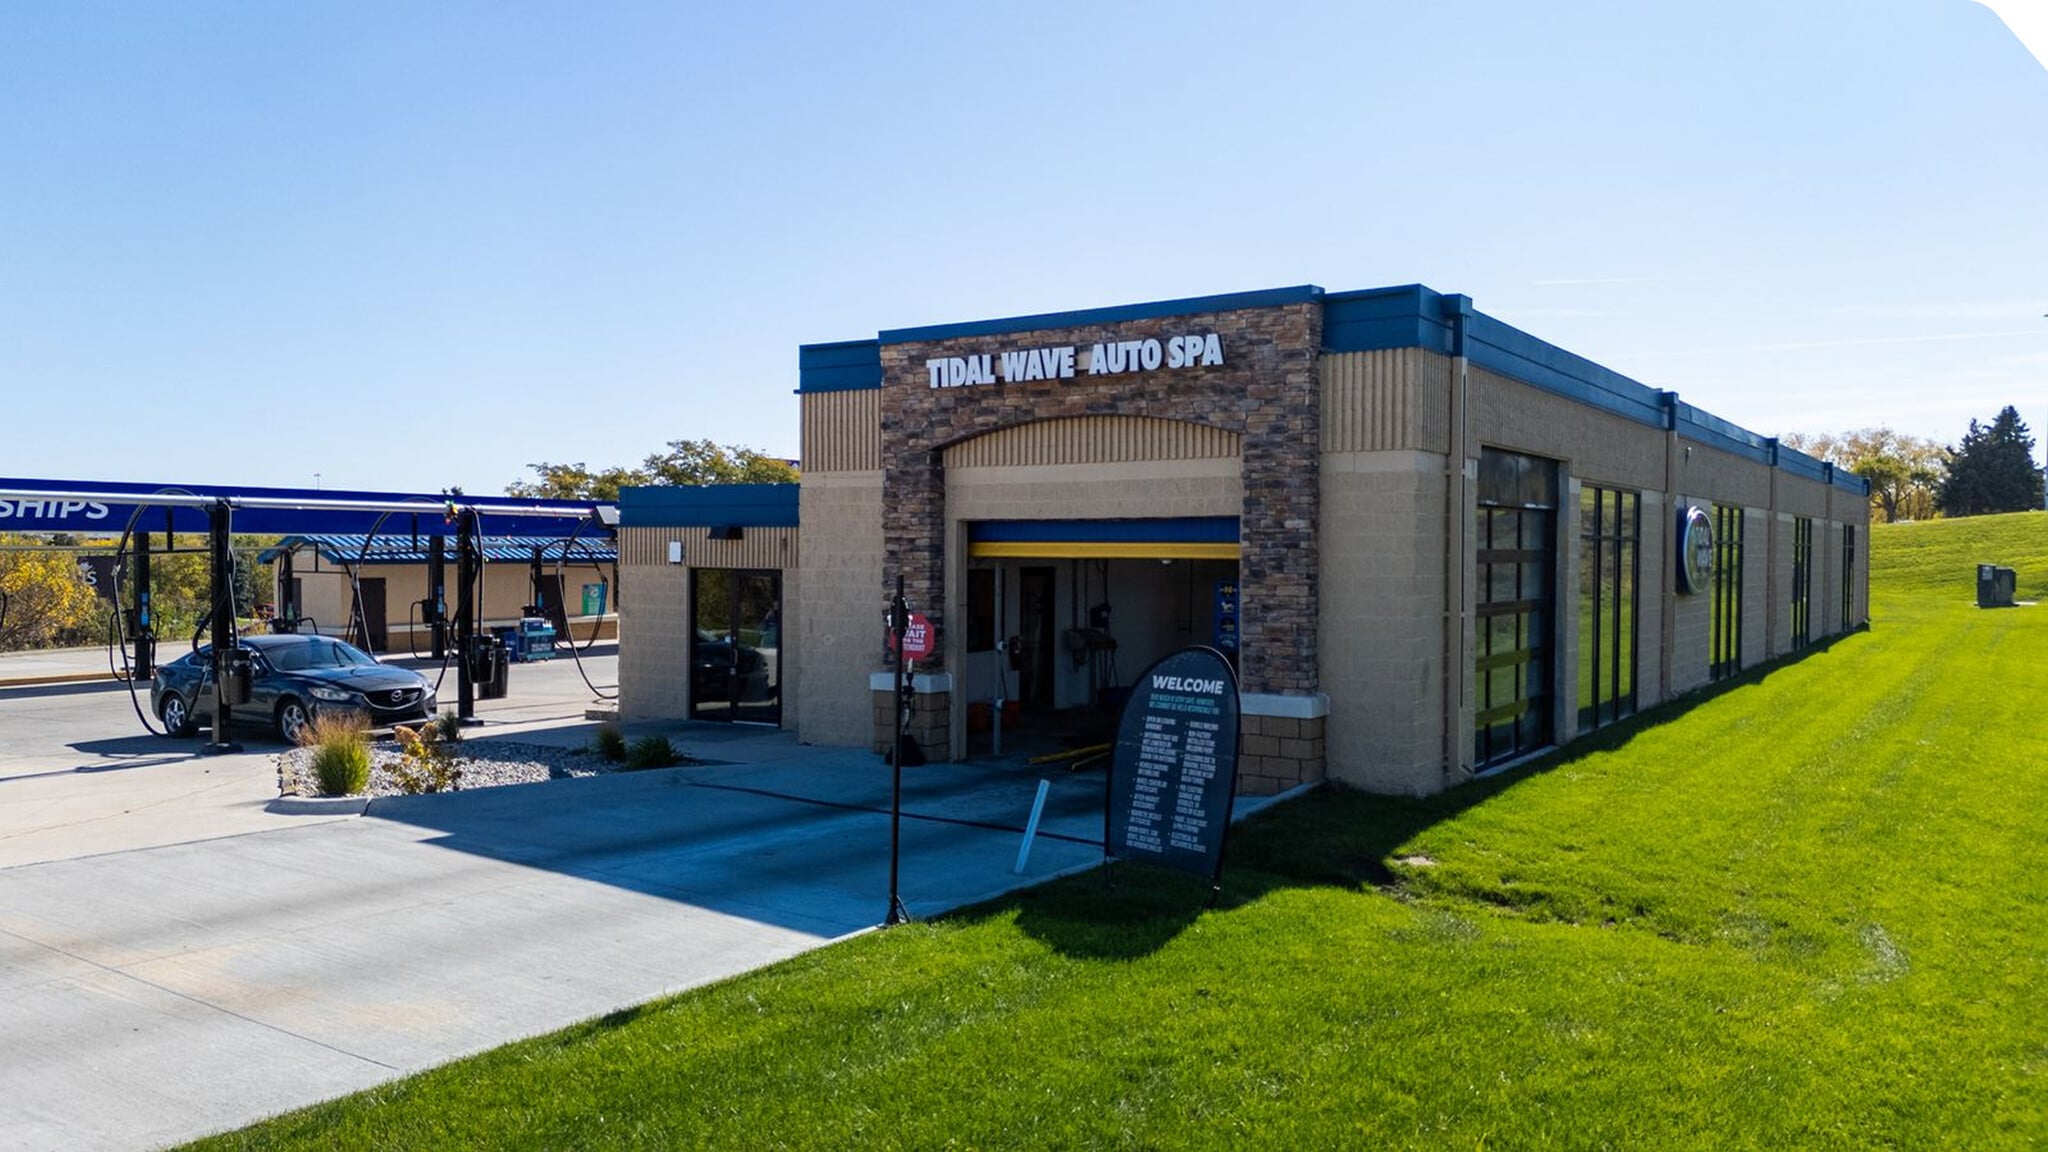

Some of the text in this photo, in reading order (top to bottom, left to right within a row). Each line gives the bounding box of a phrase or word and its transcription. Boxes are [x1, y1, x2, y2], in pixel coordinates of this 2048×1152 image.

[926, 333, 1224, 389] TIDAL WAVE AUTO SPA
[1153, 675, 1225, 695] WELCOME
